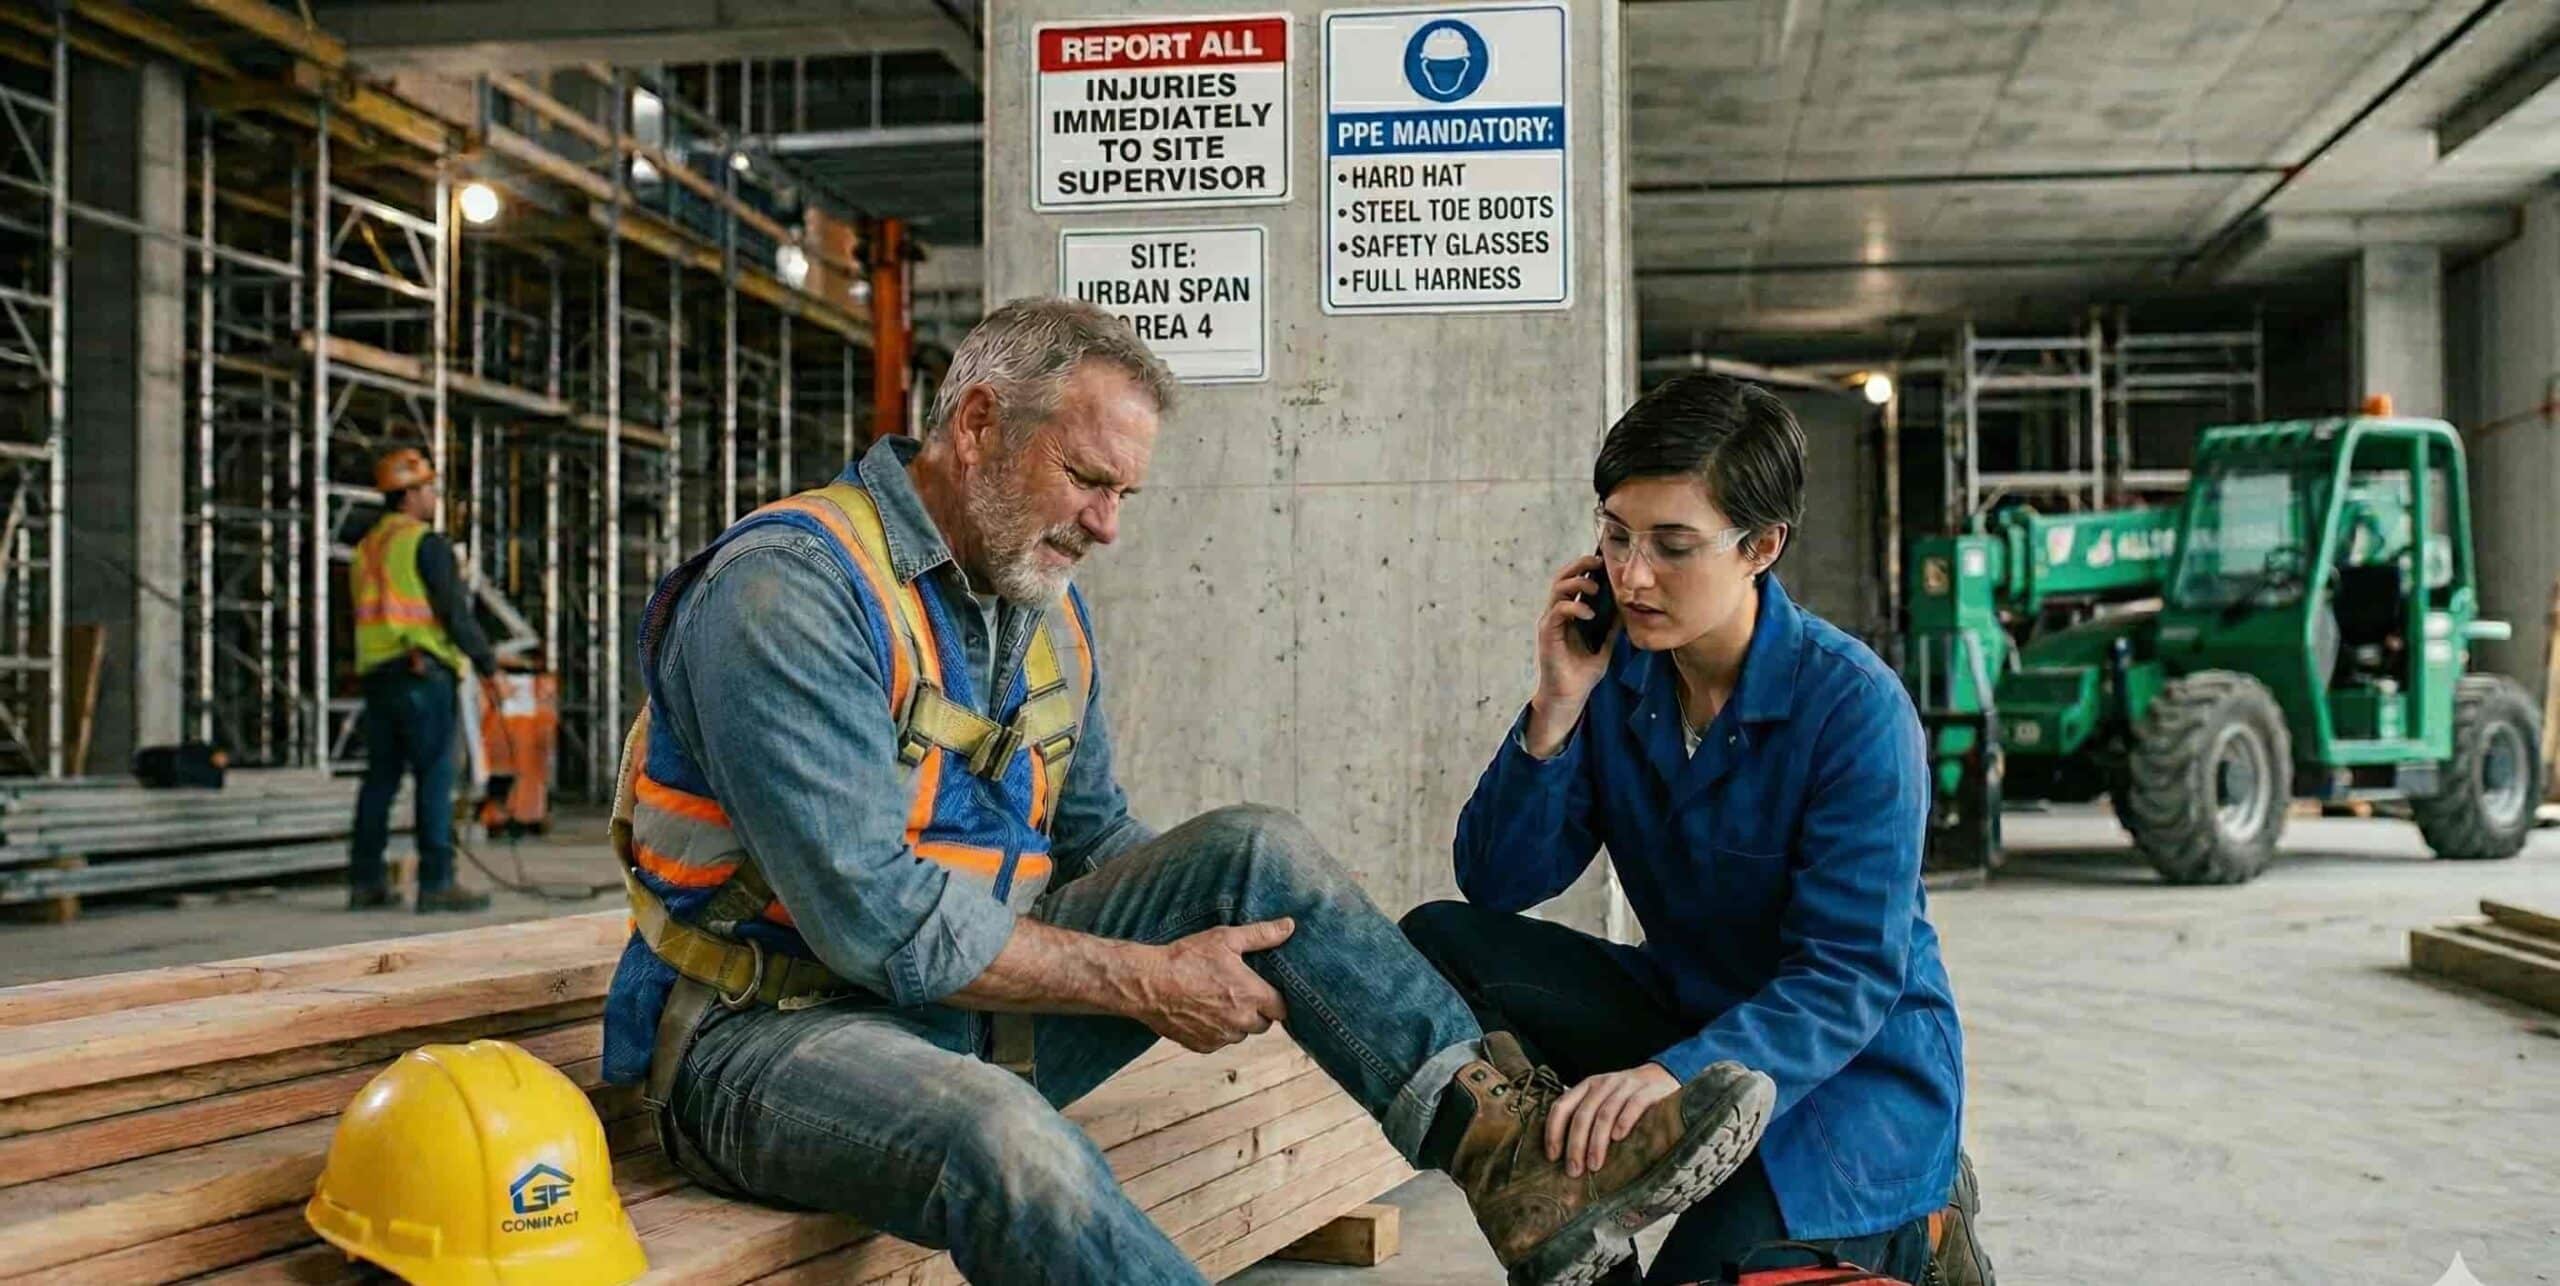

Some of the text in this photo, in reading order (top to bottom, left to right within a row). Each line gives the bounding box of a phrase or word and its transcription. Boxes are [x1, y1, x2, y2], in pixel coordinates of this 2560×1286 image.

[1061, 30, 1263, 63] REPORT ALL
[1086, 73, 1237, 102] INJURIES
[1053, 103, 1272, 134] IMMEDIATELY
[1338, 116, 1554, 148] PPE MANDATORY:
[1098, 136, 1225, 163] TO SITE
[1058, 165, 1266, 195] SUPERVISOR
[1352, 163, 1466, 189] HARD HAT
[1351, 196, 1554, 223] STEEL TOE BOOTS
[1131, 242, 1196, 269] SITE:
[1351, 230, 1550, 258] SAFETY GLASSES
[1077, 277, 1250, 304] URBAN SPAN
[1352, 266, 1521, 293] FULL HARNESS
[1197, 313, 1213, 339] 4
